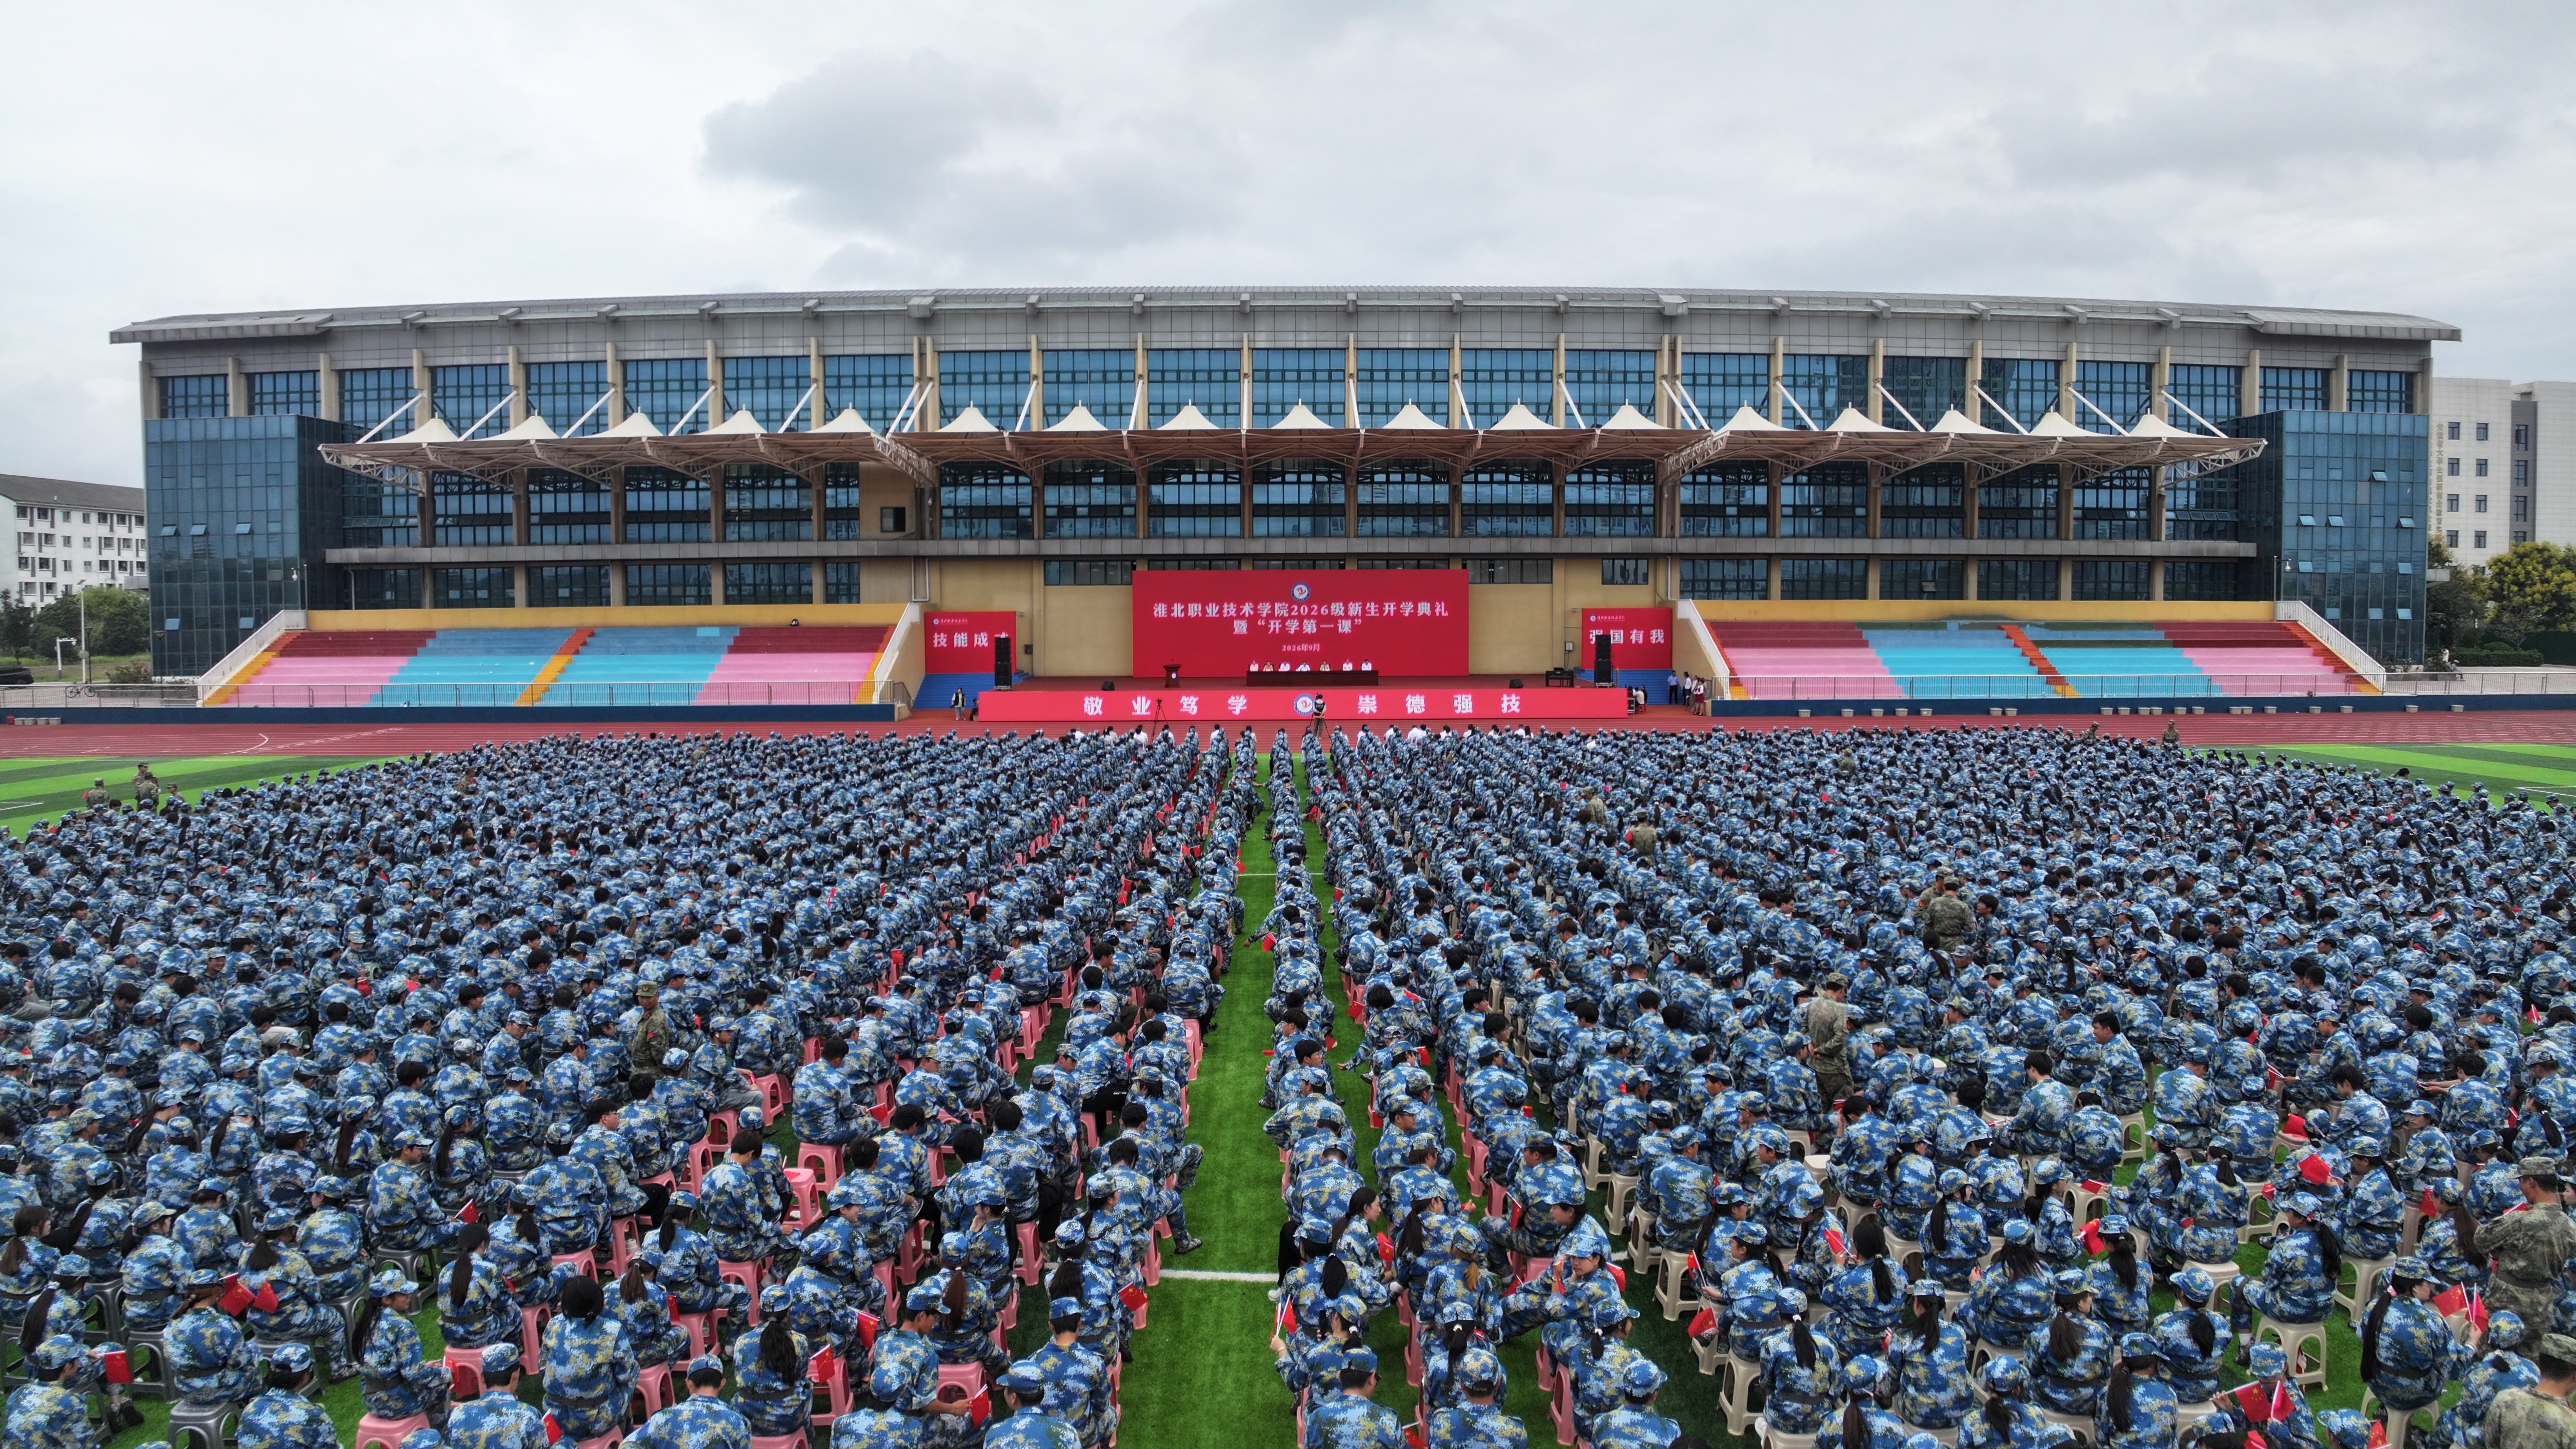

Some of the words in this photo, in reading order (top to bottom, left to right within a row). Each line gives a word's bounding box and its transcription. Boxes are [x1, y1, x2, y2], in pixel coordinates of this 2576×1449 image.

[1153, 602, 1449, 618] 淮北职业技术学院2026级新生开学典礼
[1282, 643, 1320, 652] 2026年9月
[1083, 695, 1247, 716] 敬业笃学
[1357, 693, 1521, 715] 崇德强技
